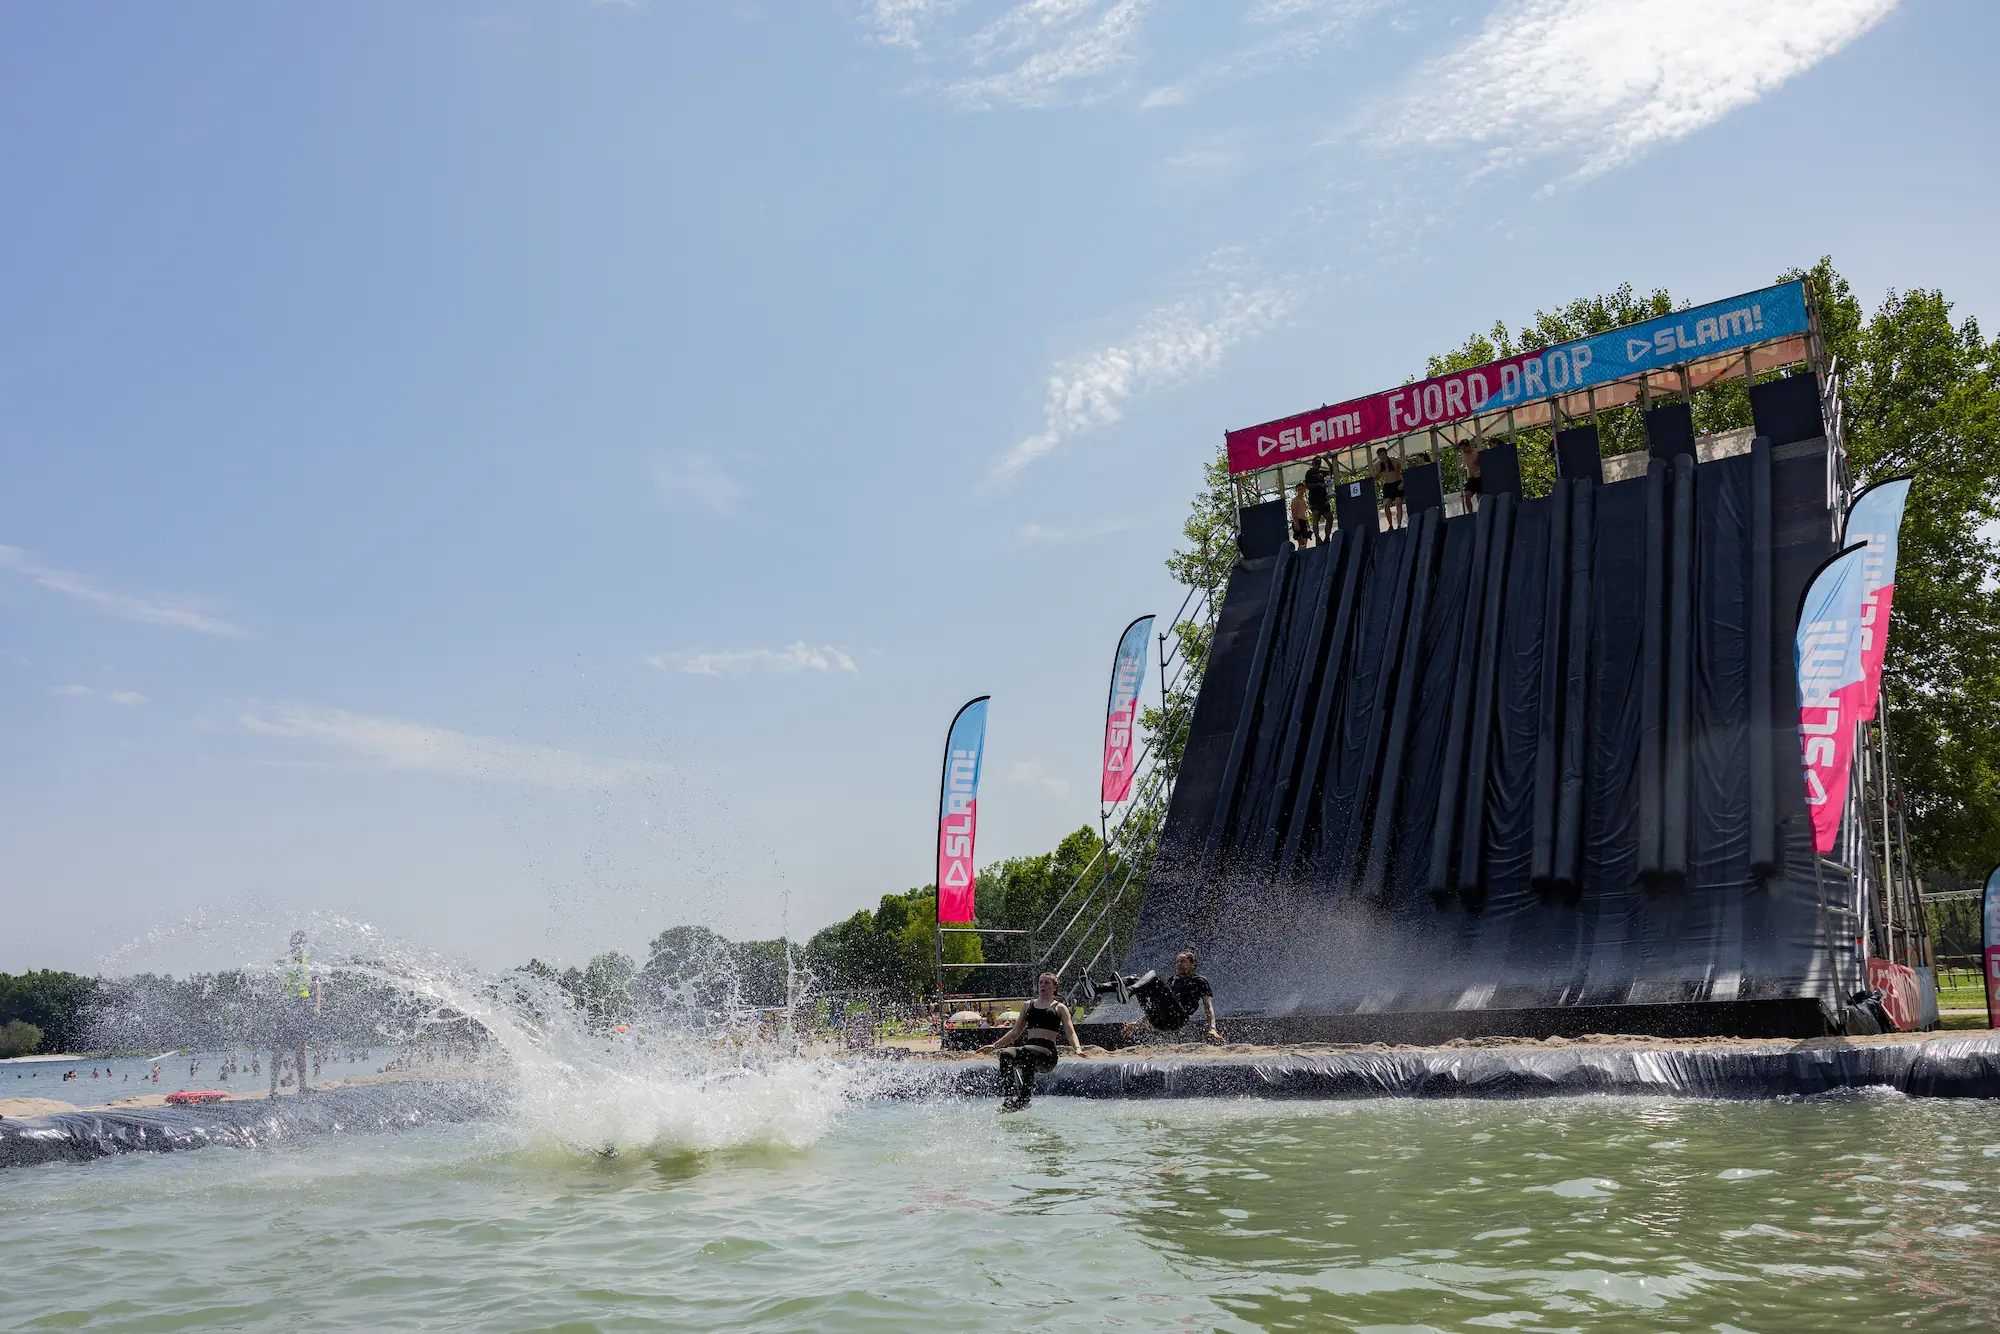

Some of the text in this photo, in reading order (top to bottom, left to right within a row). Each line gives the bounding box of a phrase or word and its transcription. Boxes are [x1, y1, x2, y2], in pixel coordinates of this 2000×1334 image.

[1279, 411, 1361, 453] SLAM!
[1388, 372, 1489, 431] FJORD
[1499, 344, 1593, 401] DROP
[1653, 304, 1764, 356] SLAM!
[1110, 658, 1139, 748] SLAM!
[1798, 620, 1848, 768] SLAM!
[946, 750, 976, 858] SLAM!
